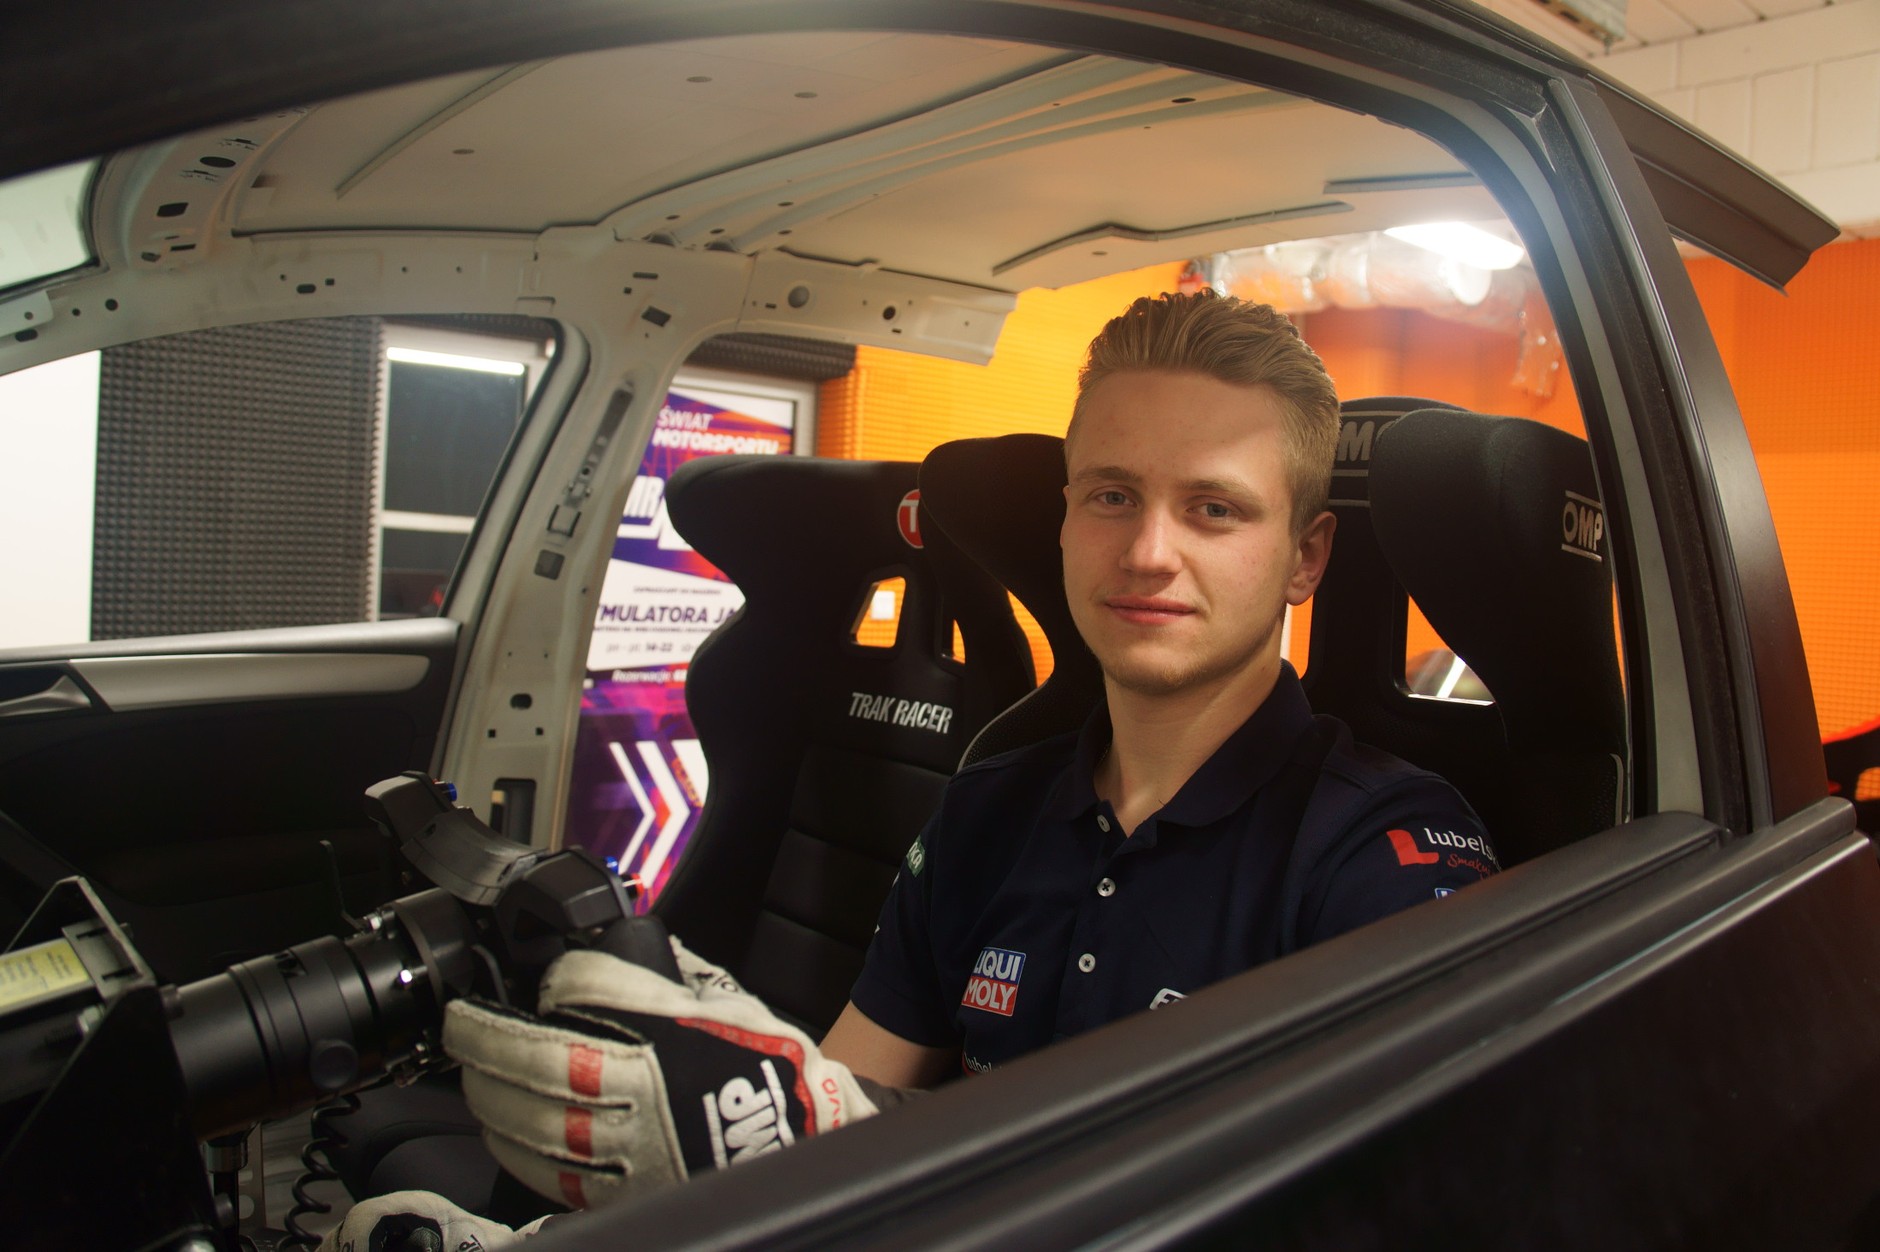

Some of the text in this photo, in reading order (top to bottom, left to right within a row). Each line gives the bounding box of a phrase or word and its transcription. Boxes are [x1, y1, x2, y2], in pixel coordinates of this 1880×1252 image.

[657, 405, 713, 432] ŚWIAT
[652, 427, 779, 454] MOTORSPORTU
[1562, 501, 1604, 551] OMP
[600, 604, 708, 623] MULATORA
[849, 692, 954, 734] TRAK RACER
[974, 949, 1022, 982] LIQUI
[963, 978, 1016, 1012] MOLY
